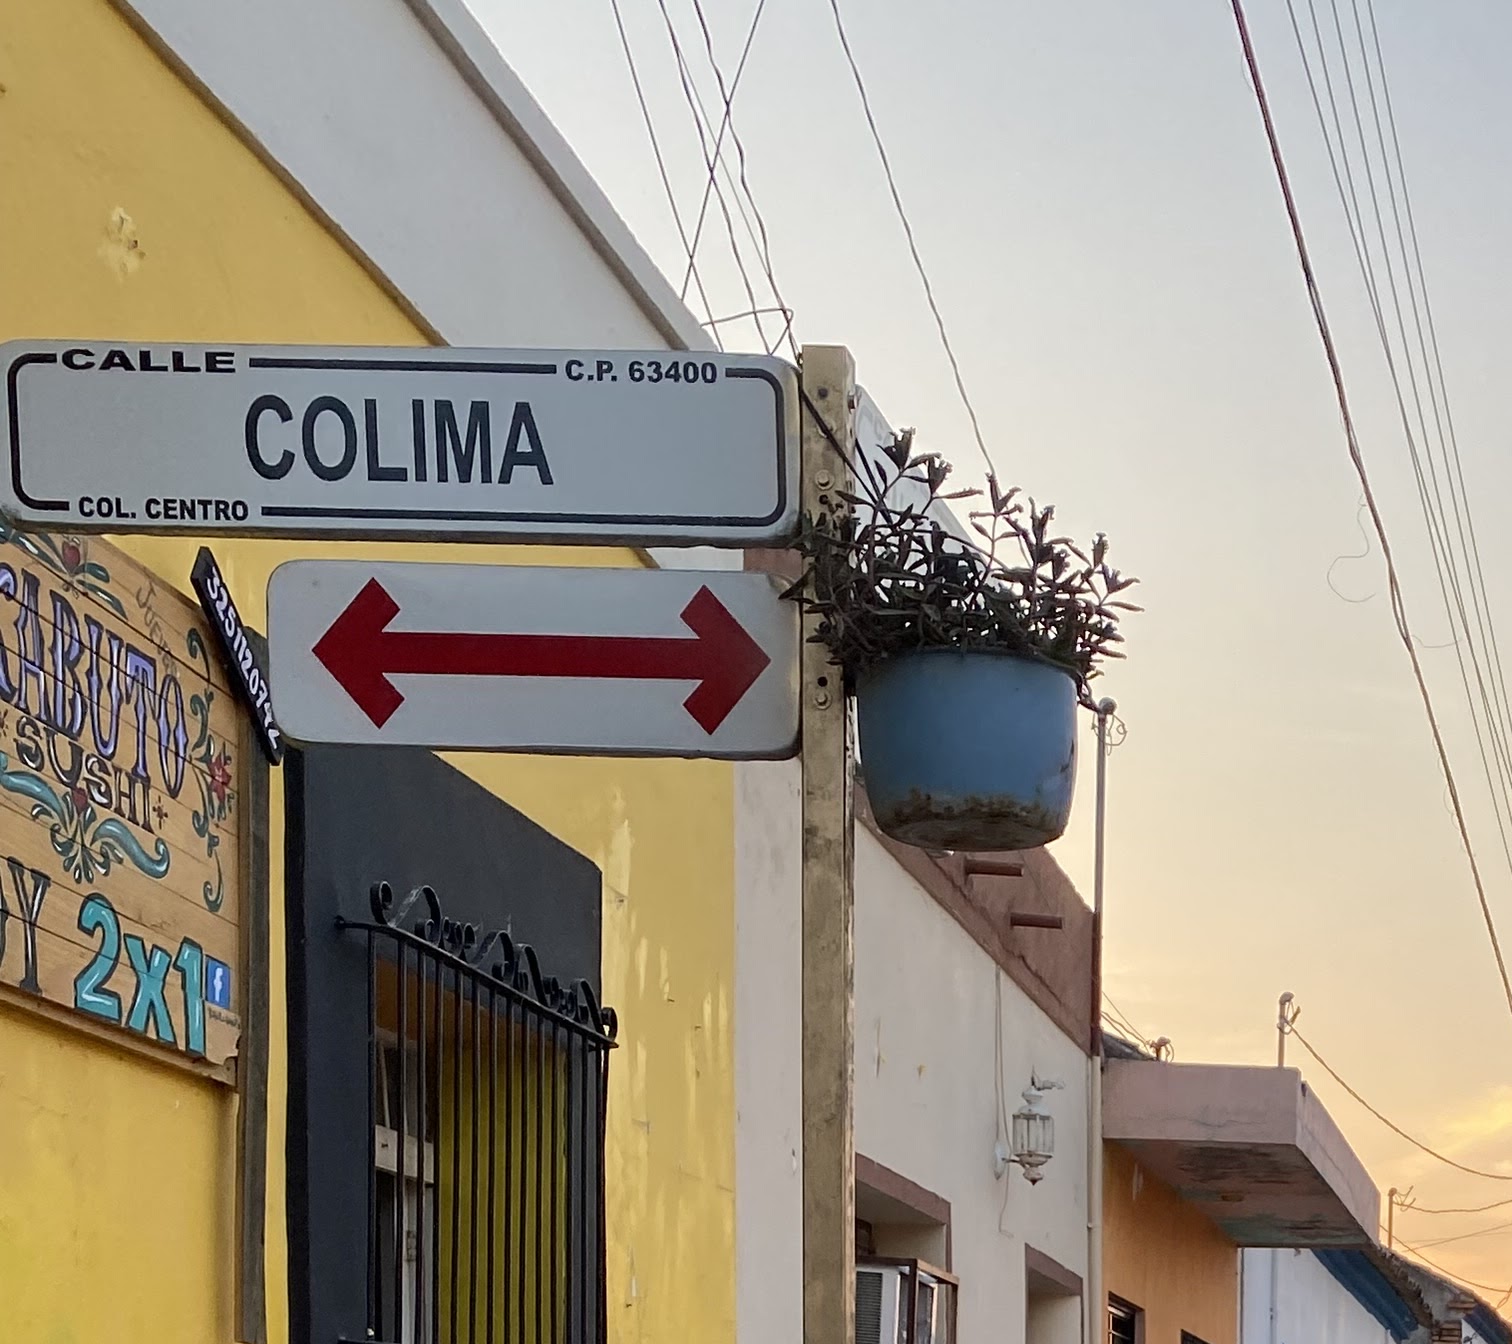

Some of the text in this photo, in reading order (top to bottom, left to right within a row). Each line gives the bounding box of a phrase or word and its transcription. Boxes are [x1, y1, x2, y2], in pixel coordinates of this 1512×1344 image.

[60, 348, 237, 374] CALLE
[564, 359, 718, 384] C.P. 63400
[244, 394, 554, 486] COLIMA
[78, 496, 249, 522] COL. CENTRO
[13, 715, 155, 835] SUSHI
